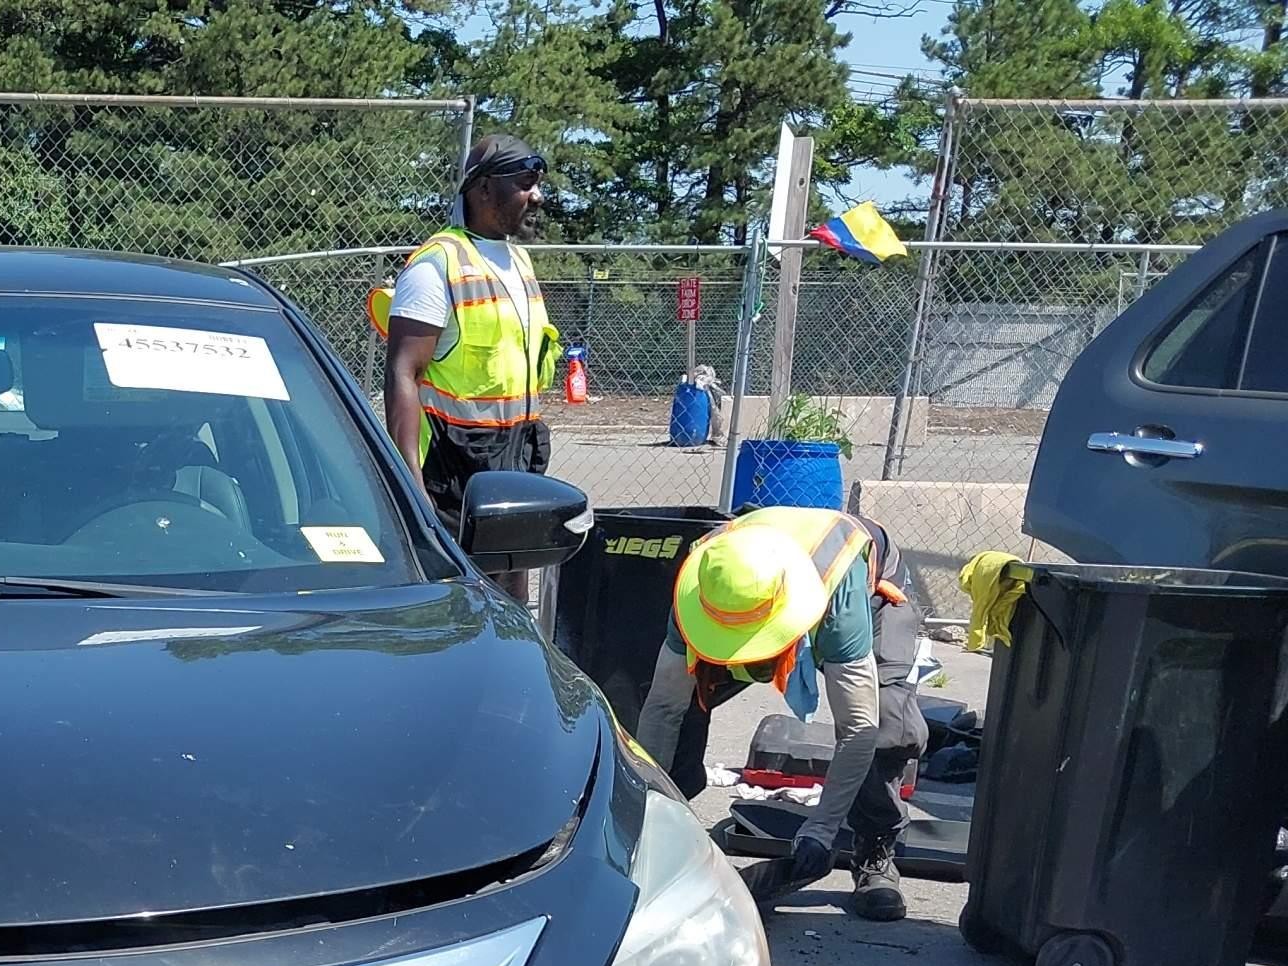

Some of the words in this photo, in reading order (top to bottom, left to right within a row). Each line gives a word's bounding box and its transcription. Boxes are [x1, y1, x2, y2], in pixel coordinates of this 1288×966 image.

[681, 278, 697, 288] STATE
[118, 337, 251, 359] 45537532
[604, 535, 683, 560] JEGS
